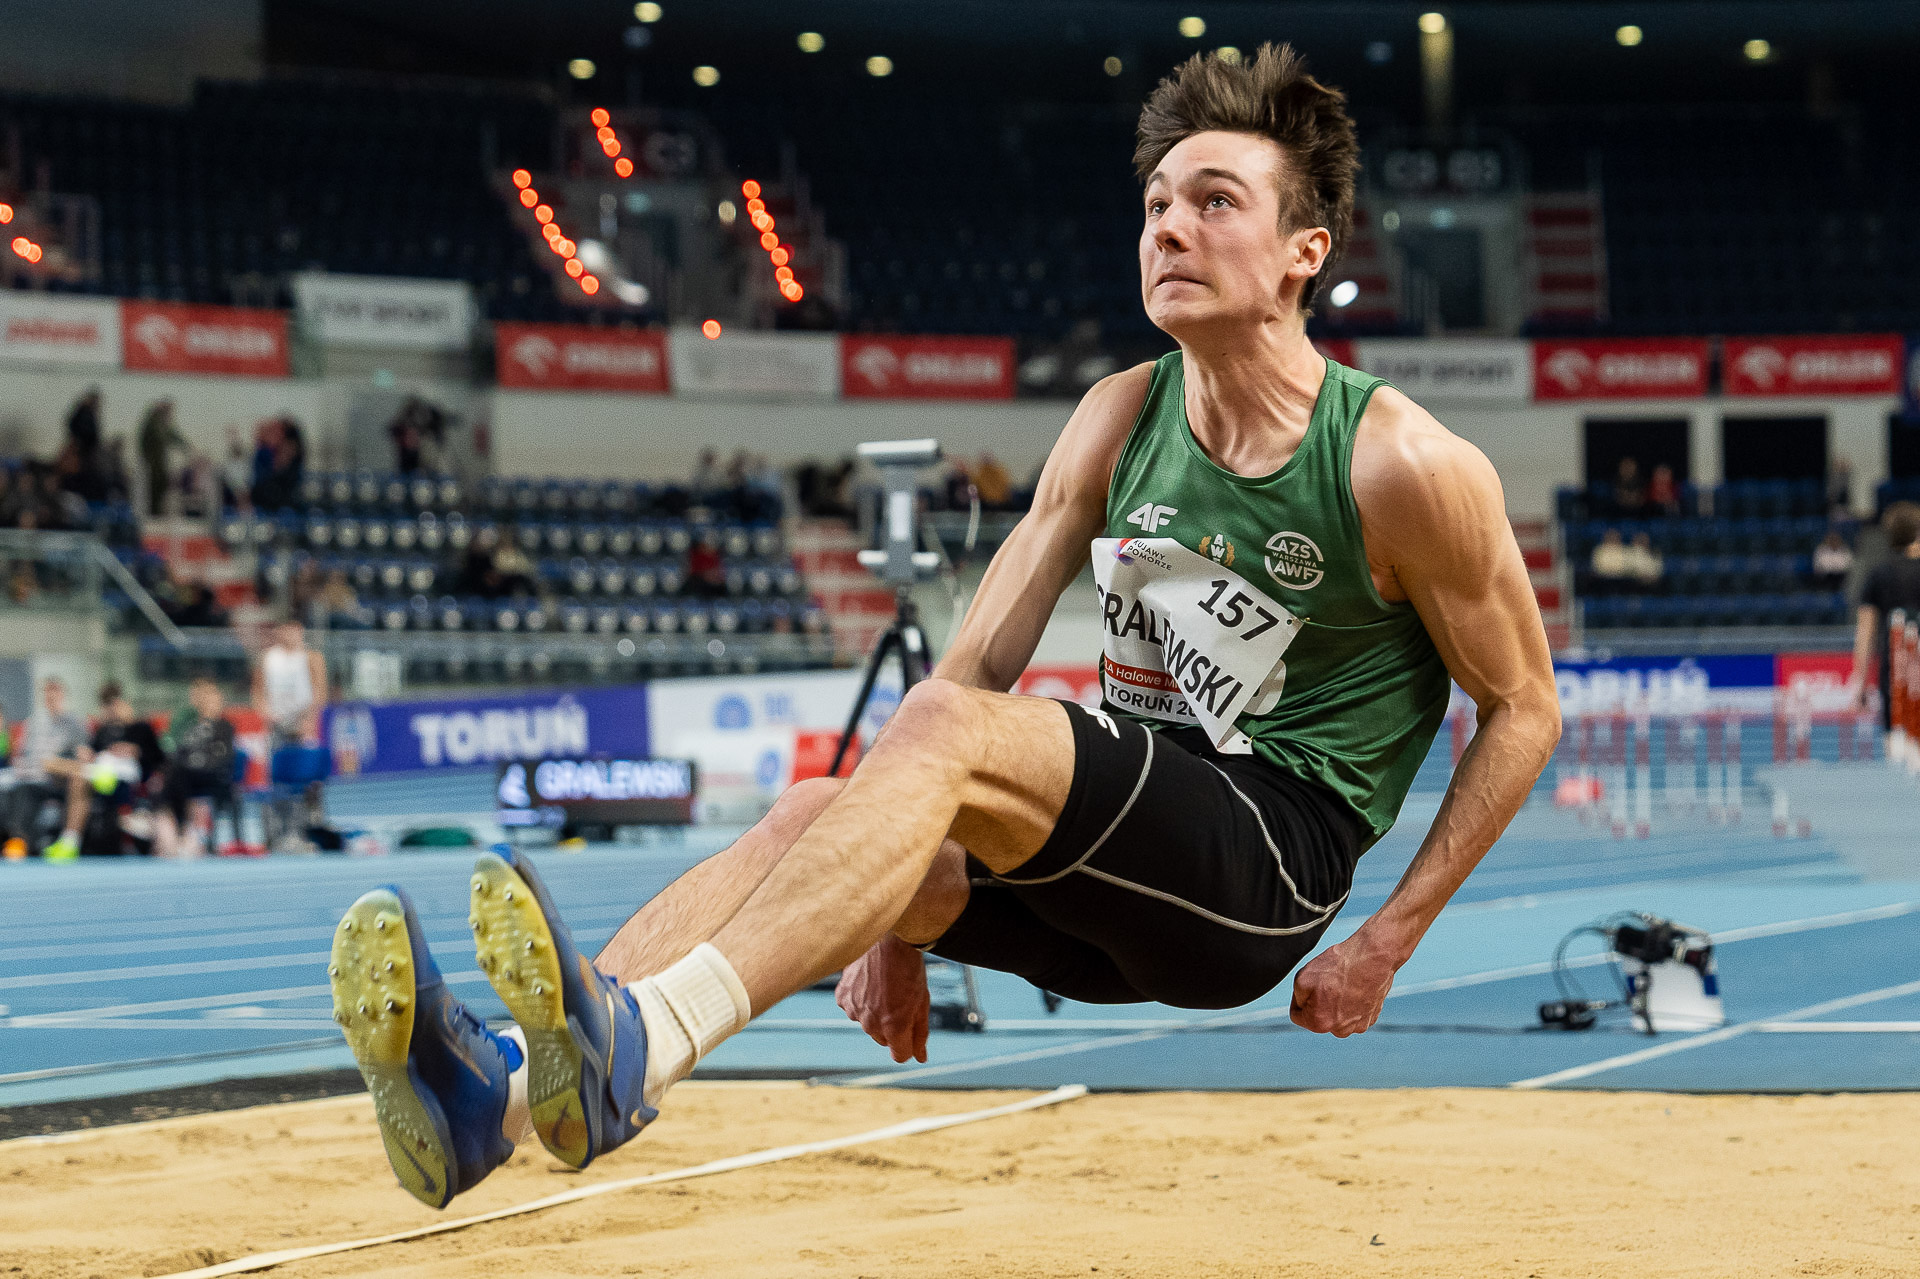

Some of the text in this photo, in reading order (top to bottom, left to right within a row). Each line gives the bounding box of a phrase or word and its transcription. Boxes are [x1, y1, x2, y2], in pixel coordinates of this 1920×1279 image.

[1126, 502, 1179, 534] 4F
[1127, 545, 1173, 571] POMORZE
[1133, 539, 1166, 561] KUJAWY
[1271, 551, 1318, 569] WARSZAWA
[1277, 539, 1312, 559] AZS
[1273, 559, 1316, 581] AWF
[1197, 579, 1280, 641] 157
[1116, 667, 1162, 686] Halowe
[1556, 659, 1710, 714] ORUŃ
[1109, 682, 1174, 714] TORUŃ
[410, 693, 589, 765] TORUŃ
